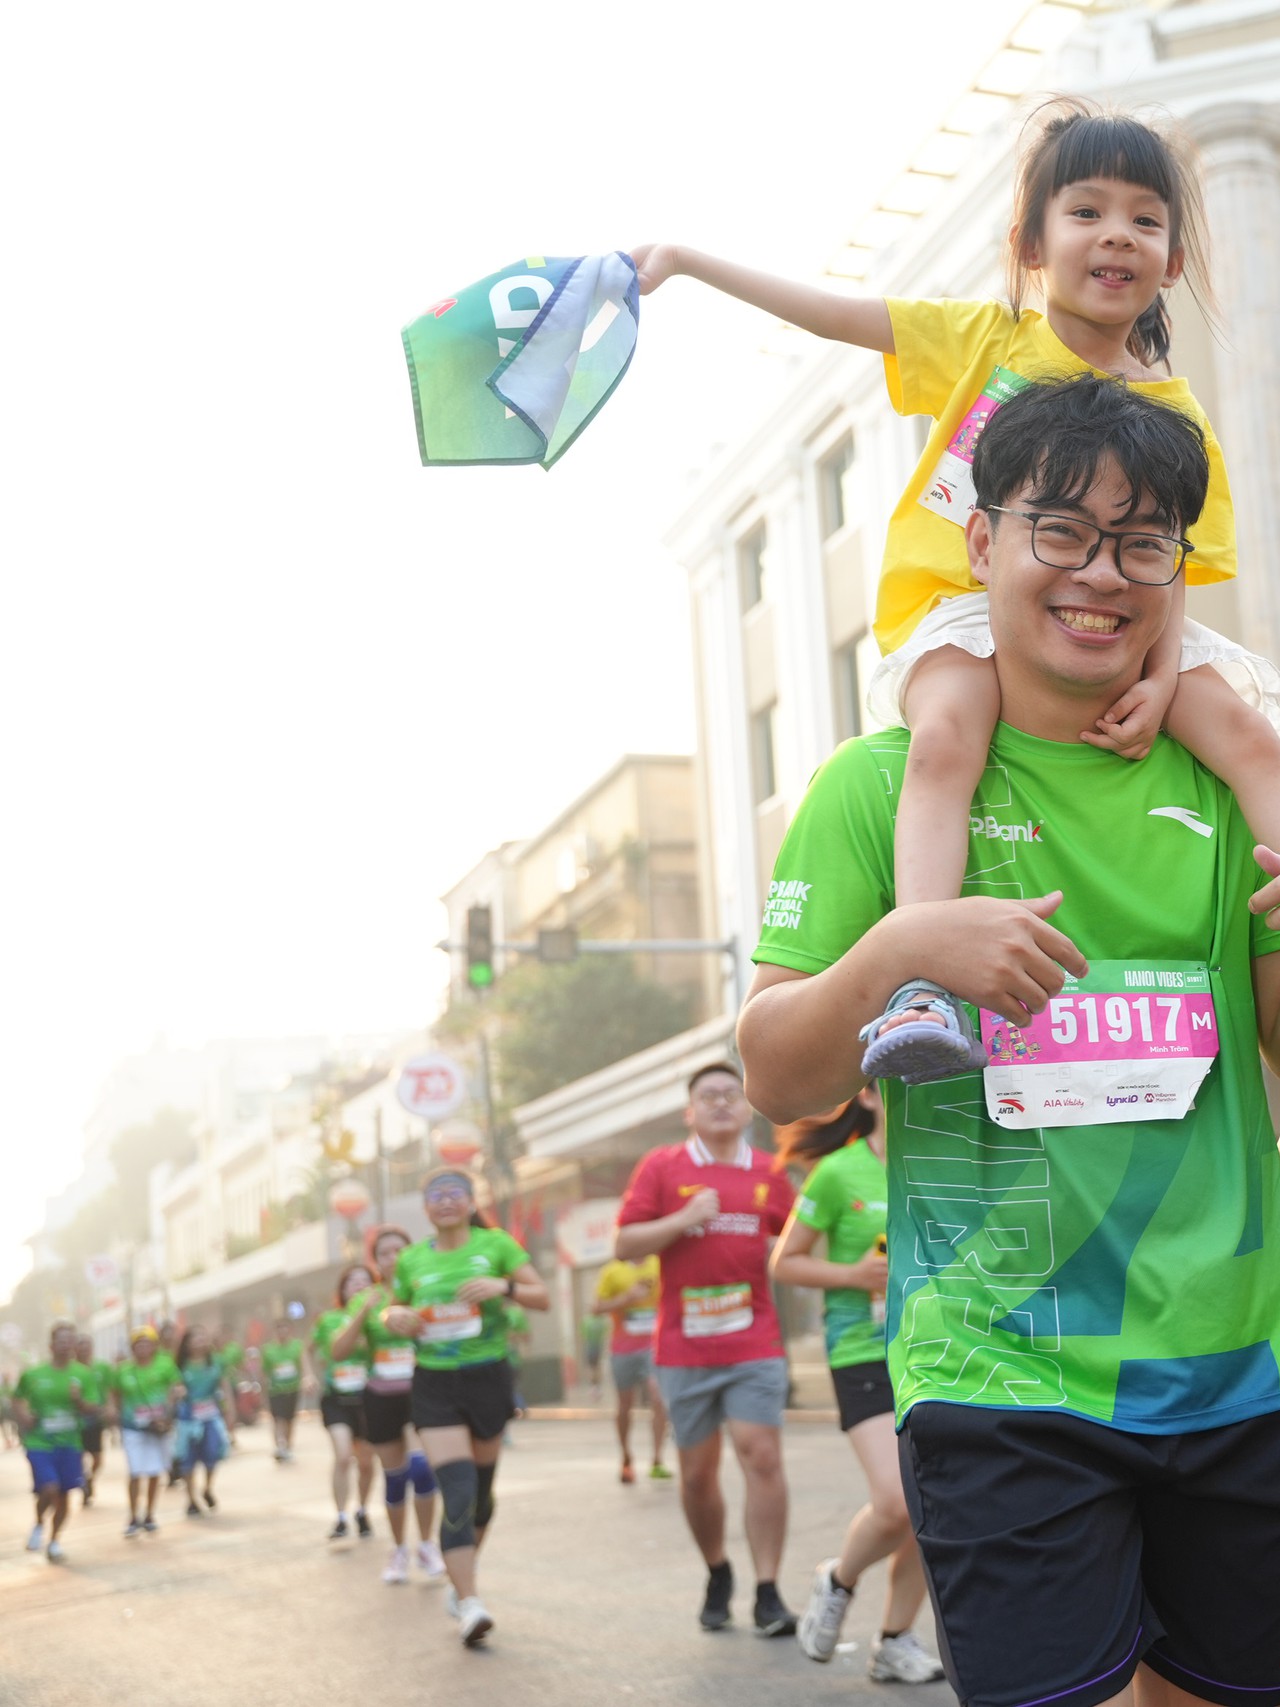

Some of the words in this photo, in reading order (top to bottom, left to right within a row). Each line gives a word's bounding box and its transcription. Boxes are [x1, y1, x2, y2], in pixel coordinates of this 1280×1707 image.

[930, 490, 944, 500] ANTA
[969, 815, 1044, 842] PBank
[1124, 970, 1156, 987] HANOI
[1157, 972, 1184, 988] VIBES
[1050, 996, 1182, 1045] 51917
[1191, 1012, 1212, 1031] M
[1149, 1045, 1168, 1053] Minh
[1043, 1099, 1062, 1107] AIA
[1063, 1098, 1084, 1108] Vitality
